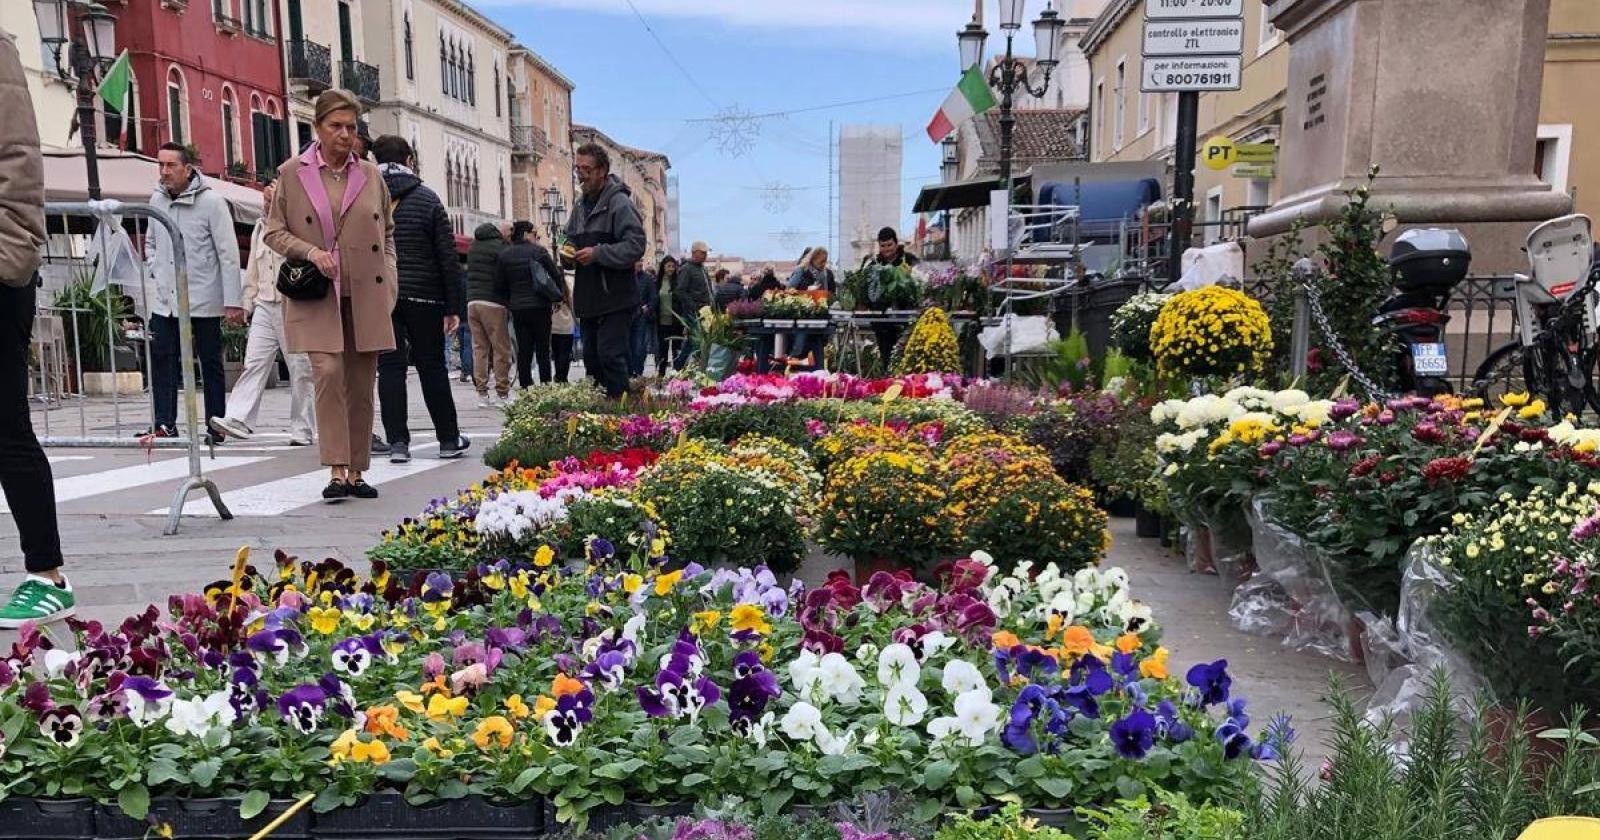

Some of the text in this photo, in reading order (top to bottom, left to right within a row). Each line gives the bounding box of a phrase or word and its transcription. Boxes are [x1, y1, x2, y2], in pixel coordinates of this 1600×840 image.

[1147, 27, 1239, 38] controllo elettronico
[1184, 38, 1200, 48] ZTL
[1171, 60, 1228, 69] informazioni:
[1166, 73, 1231, 85] 800761911
[1208, 145, 1232, 160] PT
